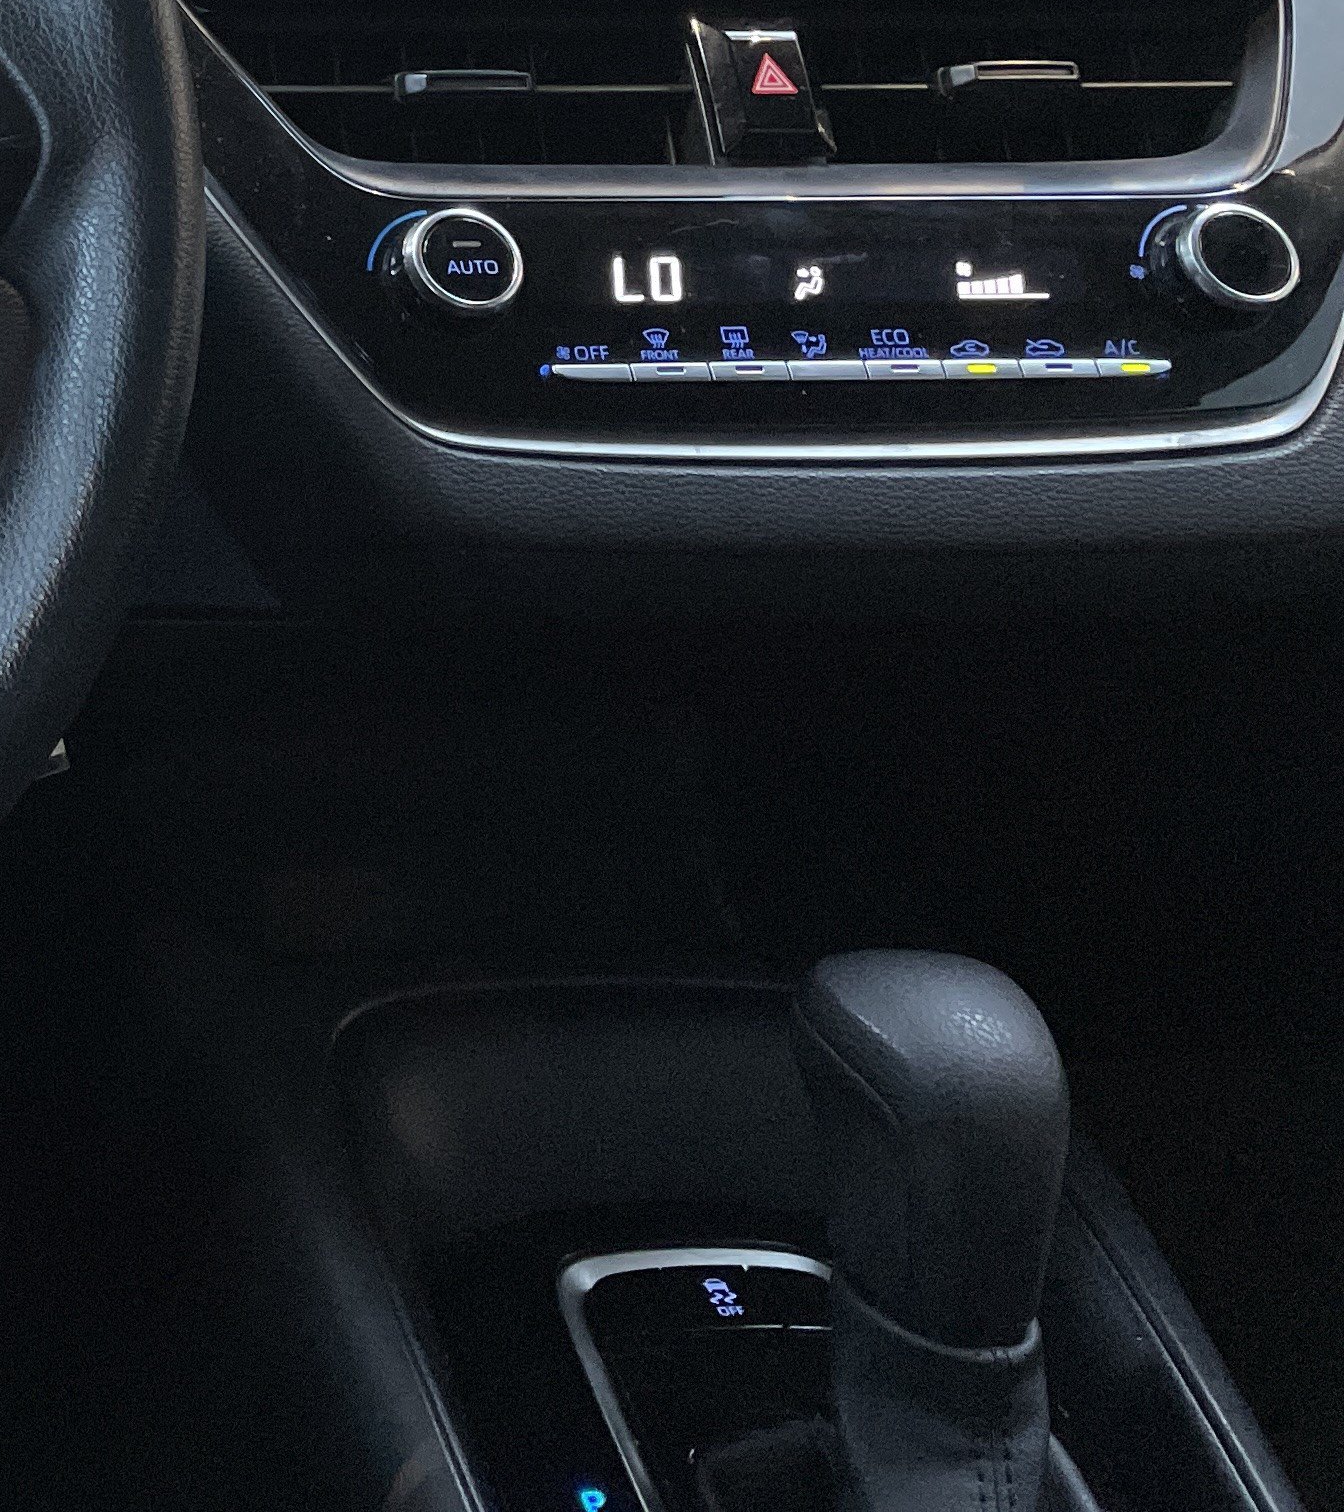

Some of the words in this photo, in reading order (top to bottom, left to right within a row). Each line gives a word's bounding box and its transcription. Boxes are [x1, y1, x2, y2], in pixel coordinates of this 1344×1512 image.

[447, 259, 499, 275] AUTO
[613, 256, 682, 301] LO
[871, 329, 909, 346] ECO
[574, 345, 610, 361] OFF
[640, 349, 679, 360] FRONT
[722, 348, 754, 360] REAR
[859, 347, 929, 359] HEAT/COOL
[1104, 339, 1139, 355] A/C
